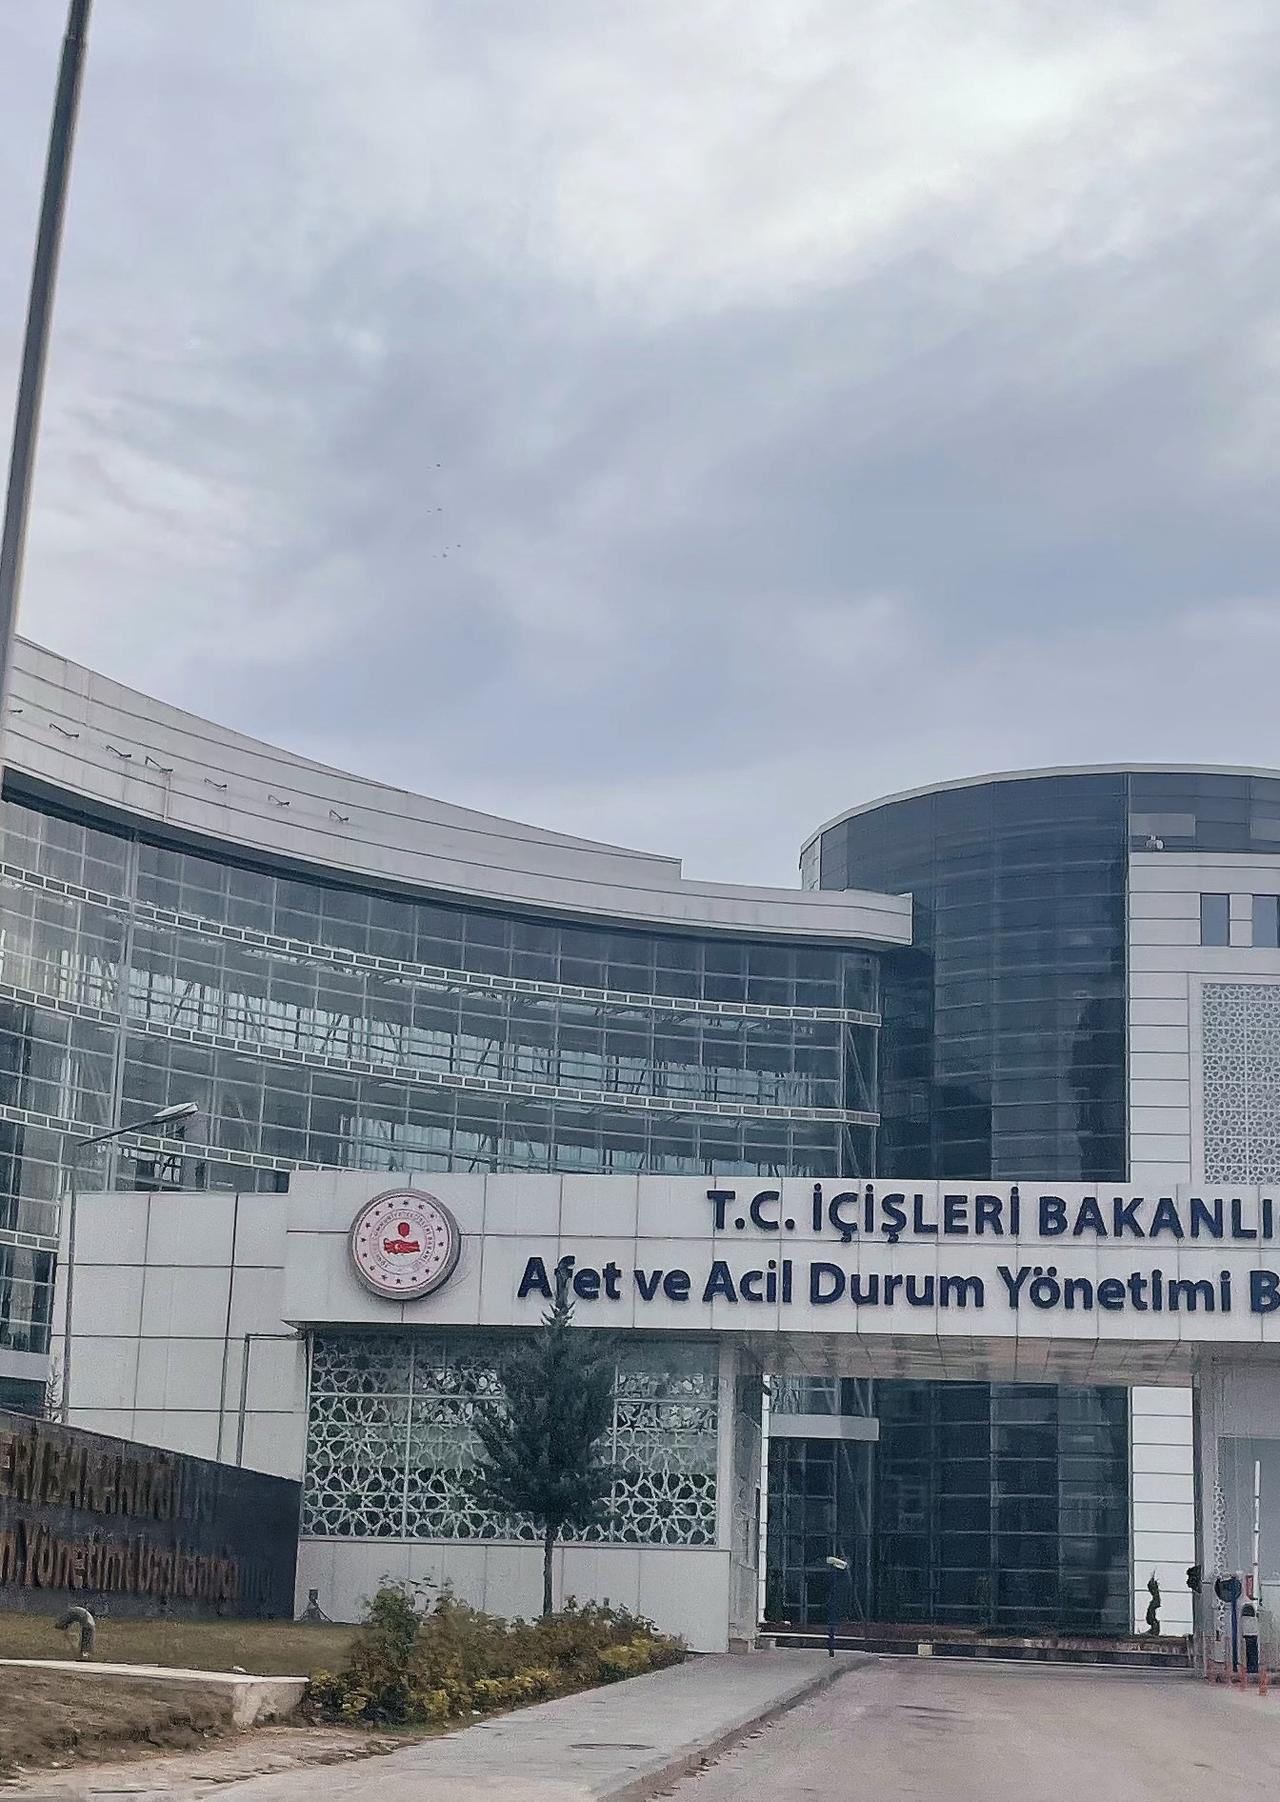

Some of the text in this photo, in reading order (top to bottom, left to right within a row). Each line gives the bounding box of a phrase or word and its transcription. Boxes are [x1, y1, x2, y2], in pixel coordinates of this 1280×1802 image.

[706, 1189, 795, 1230] T.C.
[811, 1182, 1019, 1244] İÇİŞLERİ
[517, 1255, 623, 1300] Afet
[632, 1268, 692, 1301] ve
[701, 1259, 793, 1304] Acil
[809, 1261, 985, 1309] Durum
[996, 1265, 1232, 1313] Yönetimi
